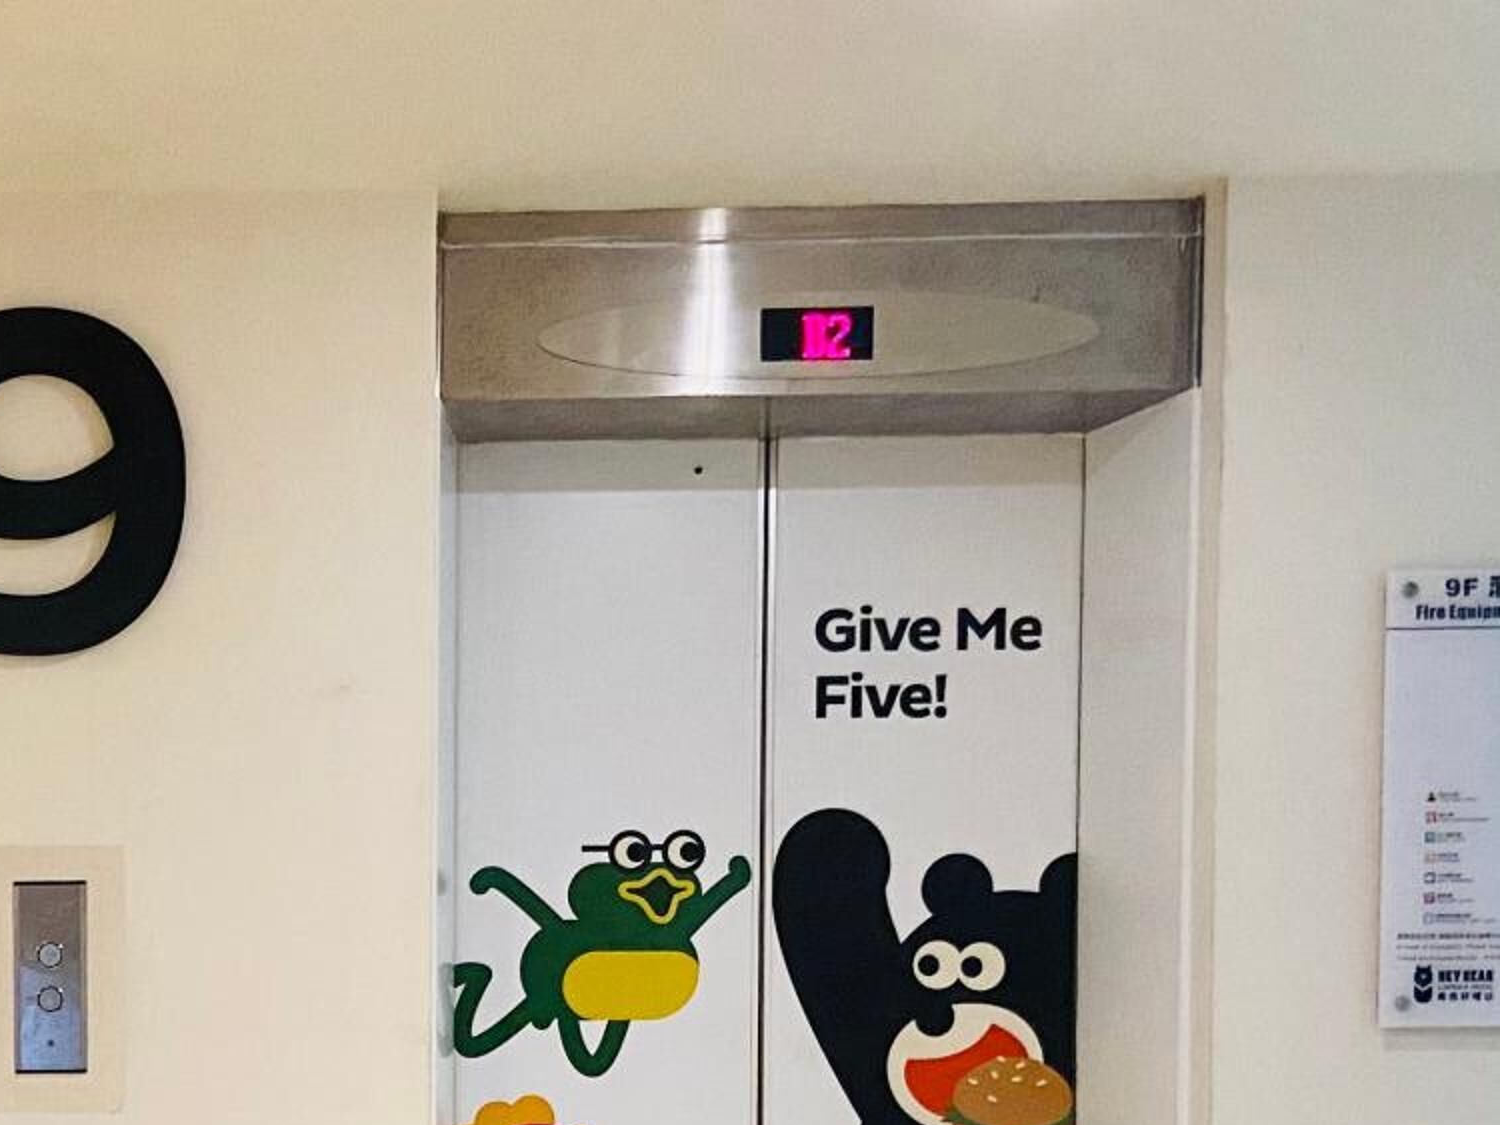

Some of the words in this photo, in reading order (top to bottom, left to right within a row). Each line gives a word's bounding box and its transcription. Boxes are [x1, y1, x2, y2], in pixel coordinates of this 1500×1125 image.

[1445, 577, 1479, 598] 9F
[815, 605, 941, 652] Give
[957, 607, 1043, 651] Me
[1415, 605, 1446, 620] Fire
[815, 672, 947, 719] Five!
